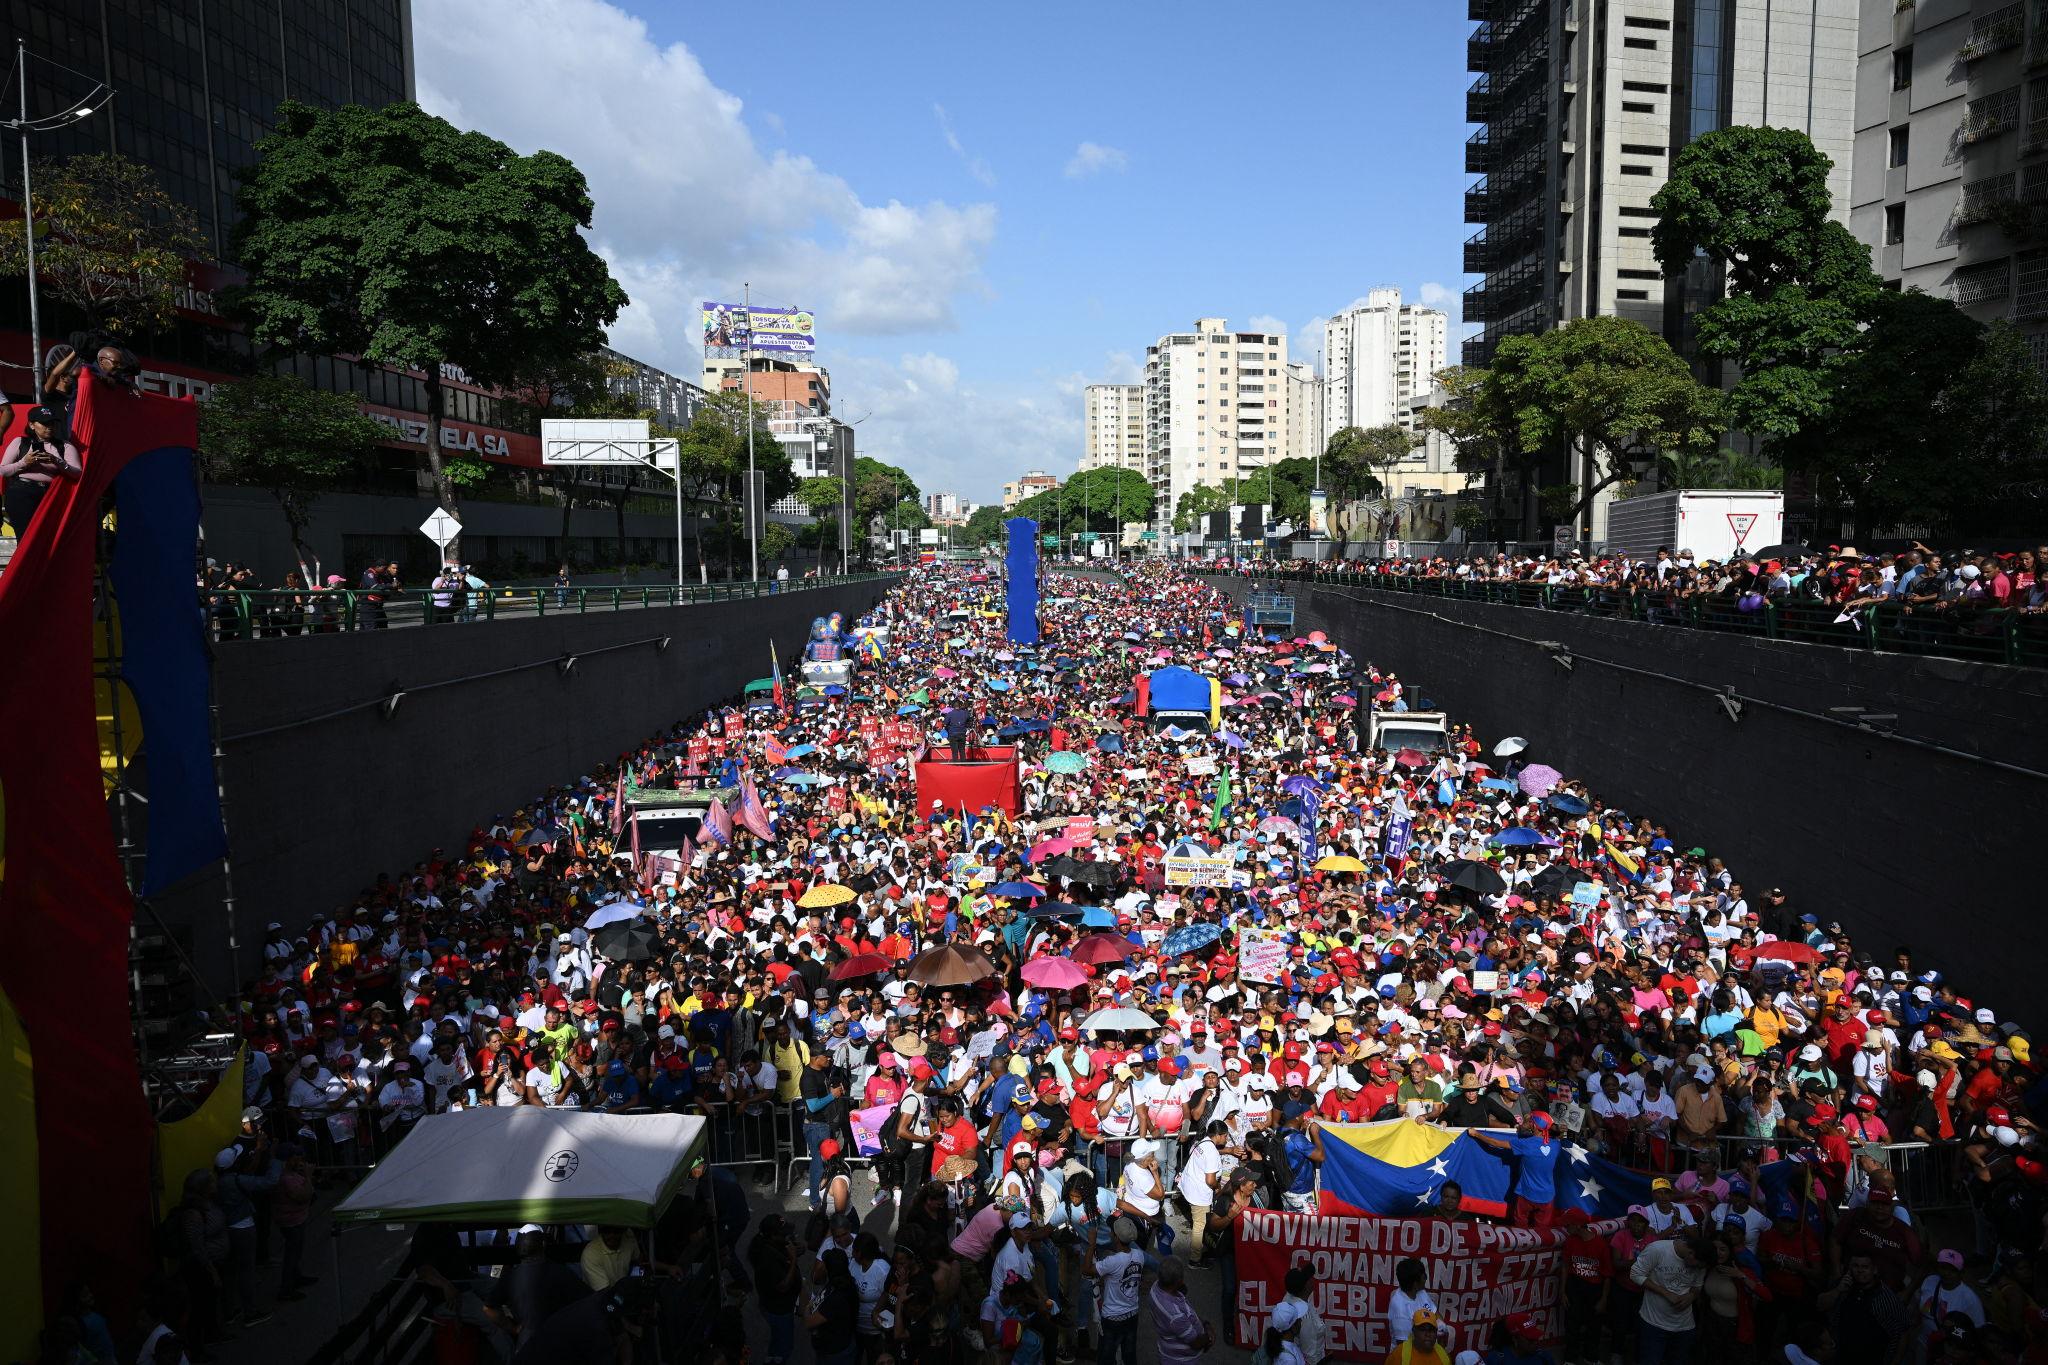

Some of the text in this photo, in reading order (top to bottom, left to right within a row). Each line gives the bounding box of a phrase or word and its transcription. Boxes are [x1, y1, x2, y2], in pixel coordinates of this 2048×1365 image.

[484, 434, 510, 457] SA
[726, 729, 744, 739] ALBA
[862, 731, 878, 739] ALBA
[900, 737, 914, 746] ALBA
[871, 753, 891, 767] ALBA
[1241, 1210, 1421, 1253] MOVIMIENTO
[1430, 1220, 1470, 1257] DE
[1239, 1280, 1274, 1313] EL
